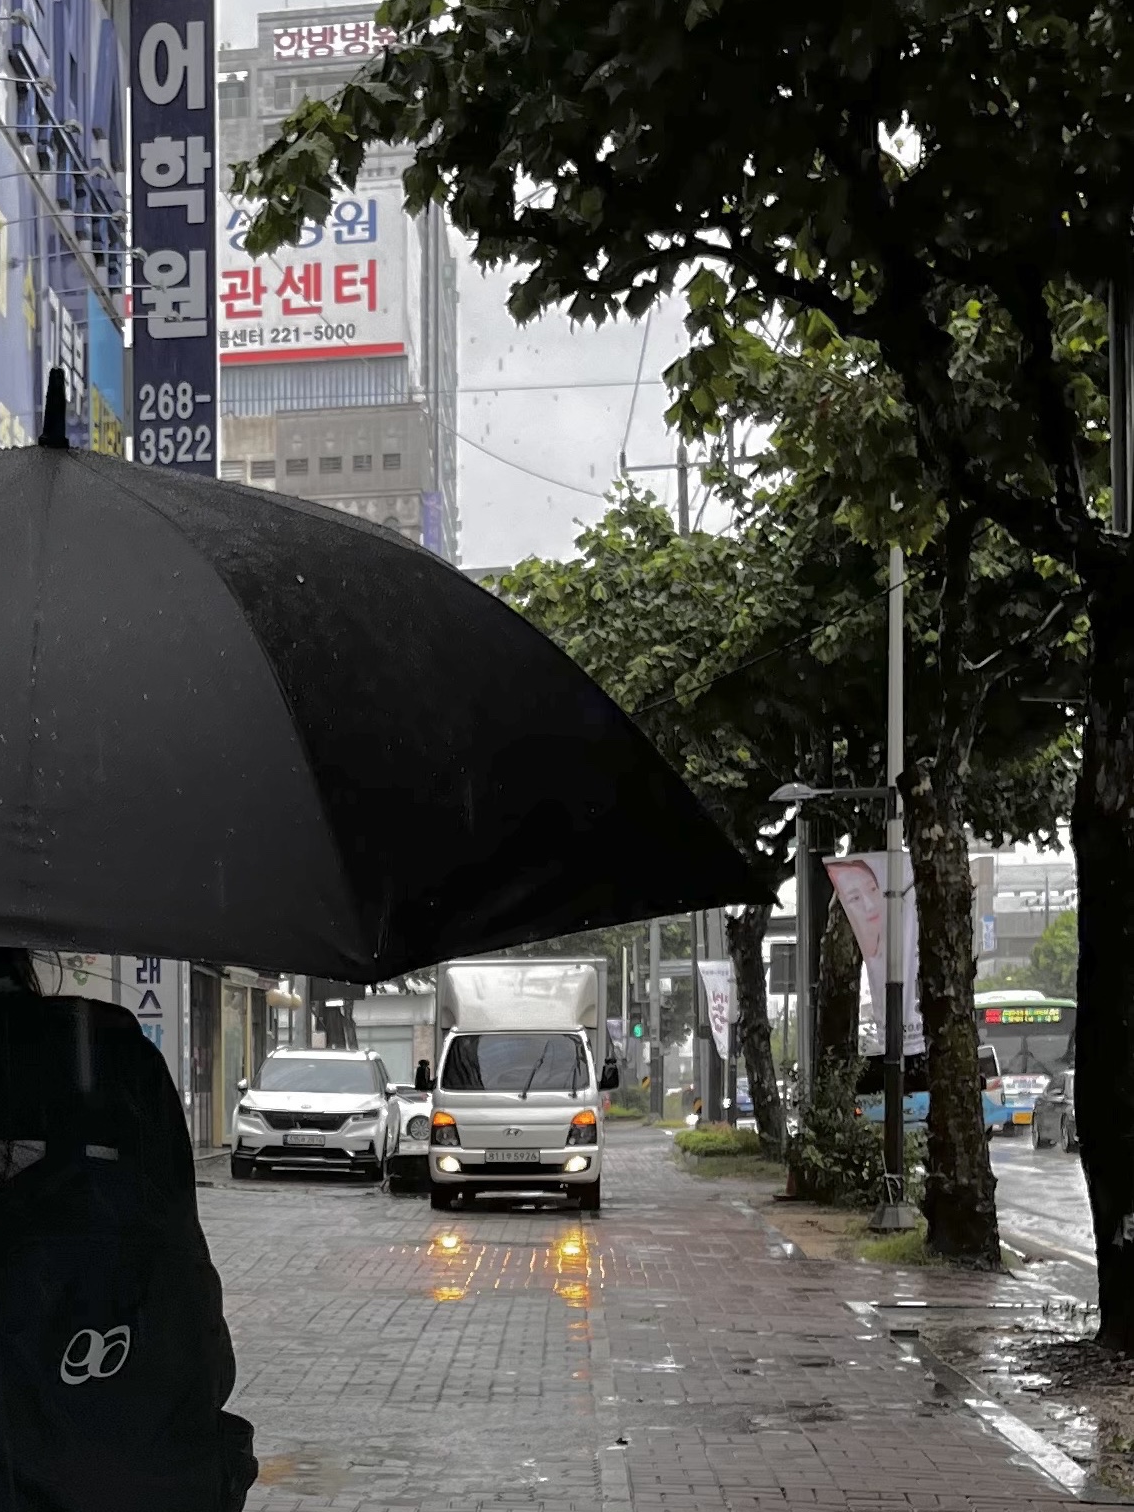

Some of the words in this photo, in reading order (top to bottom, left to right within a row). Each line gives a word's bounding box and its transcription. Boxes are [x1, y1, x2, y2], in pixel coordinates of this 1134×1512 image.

[139, 21, 212, 340] 어학원
[219, 259, 377, 320] 관센터
[270, 323, 356, 344] 221-5000
[139, 382, 212, 421] 268-
[139, 425, 213, 466] 3522
